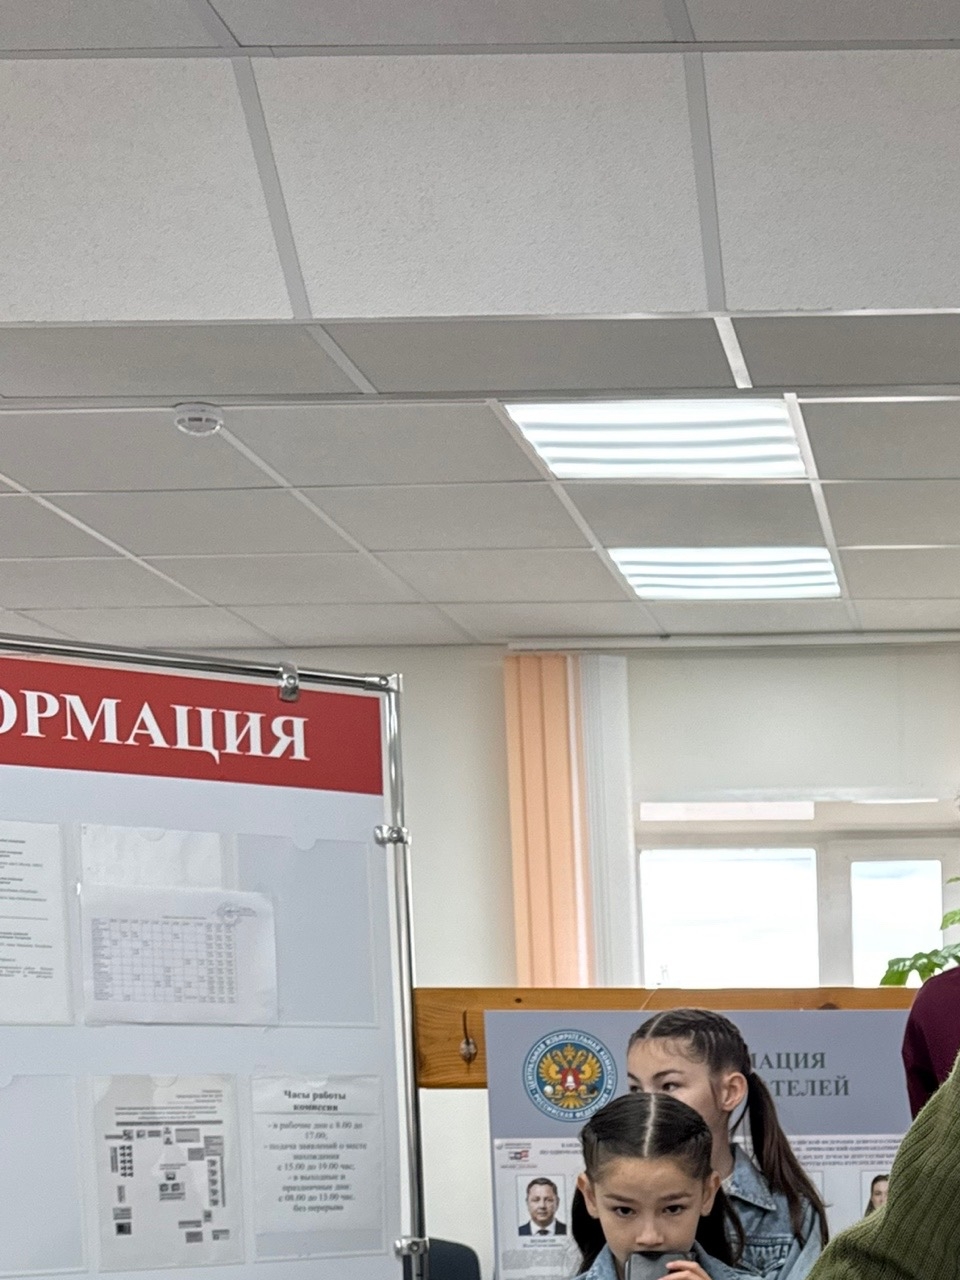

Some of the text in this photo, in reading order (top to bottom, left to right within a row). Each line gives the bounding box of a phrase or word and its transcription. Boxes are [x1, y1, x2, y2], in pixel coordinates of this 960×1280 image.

[770, 1075, 850, 1097] ТЕЛЕЙ
[284, 1090, 346, 1101] Часы работы
